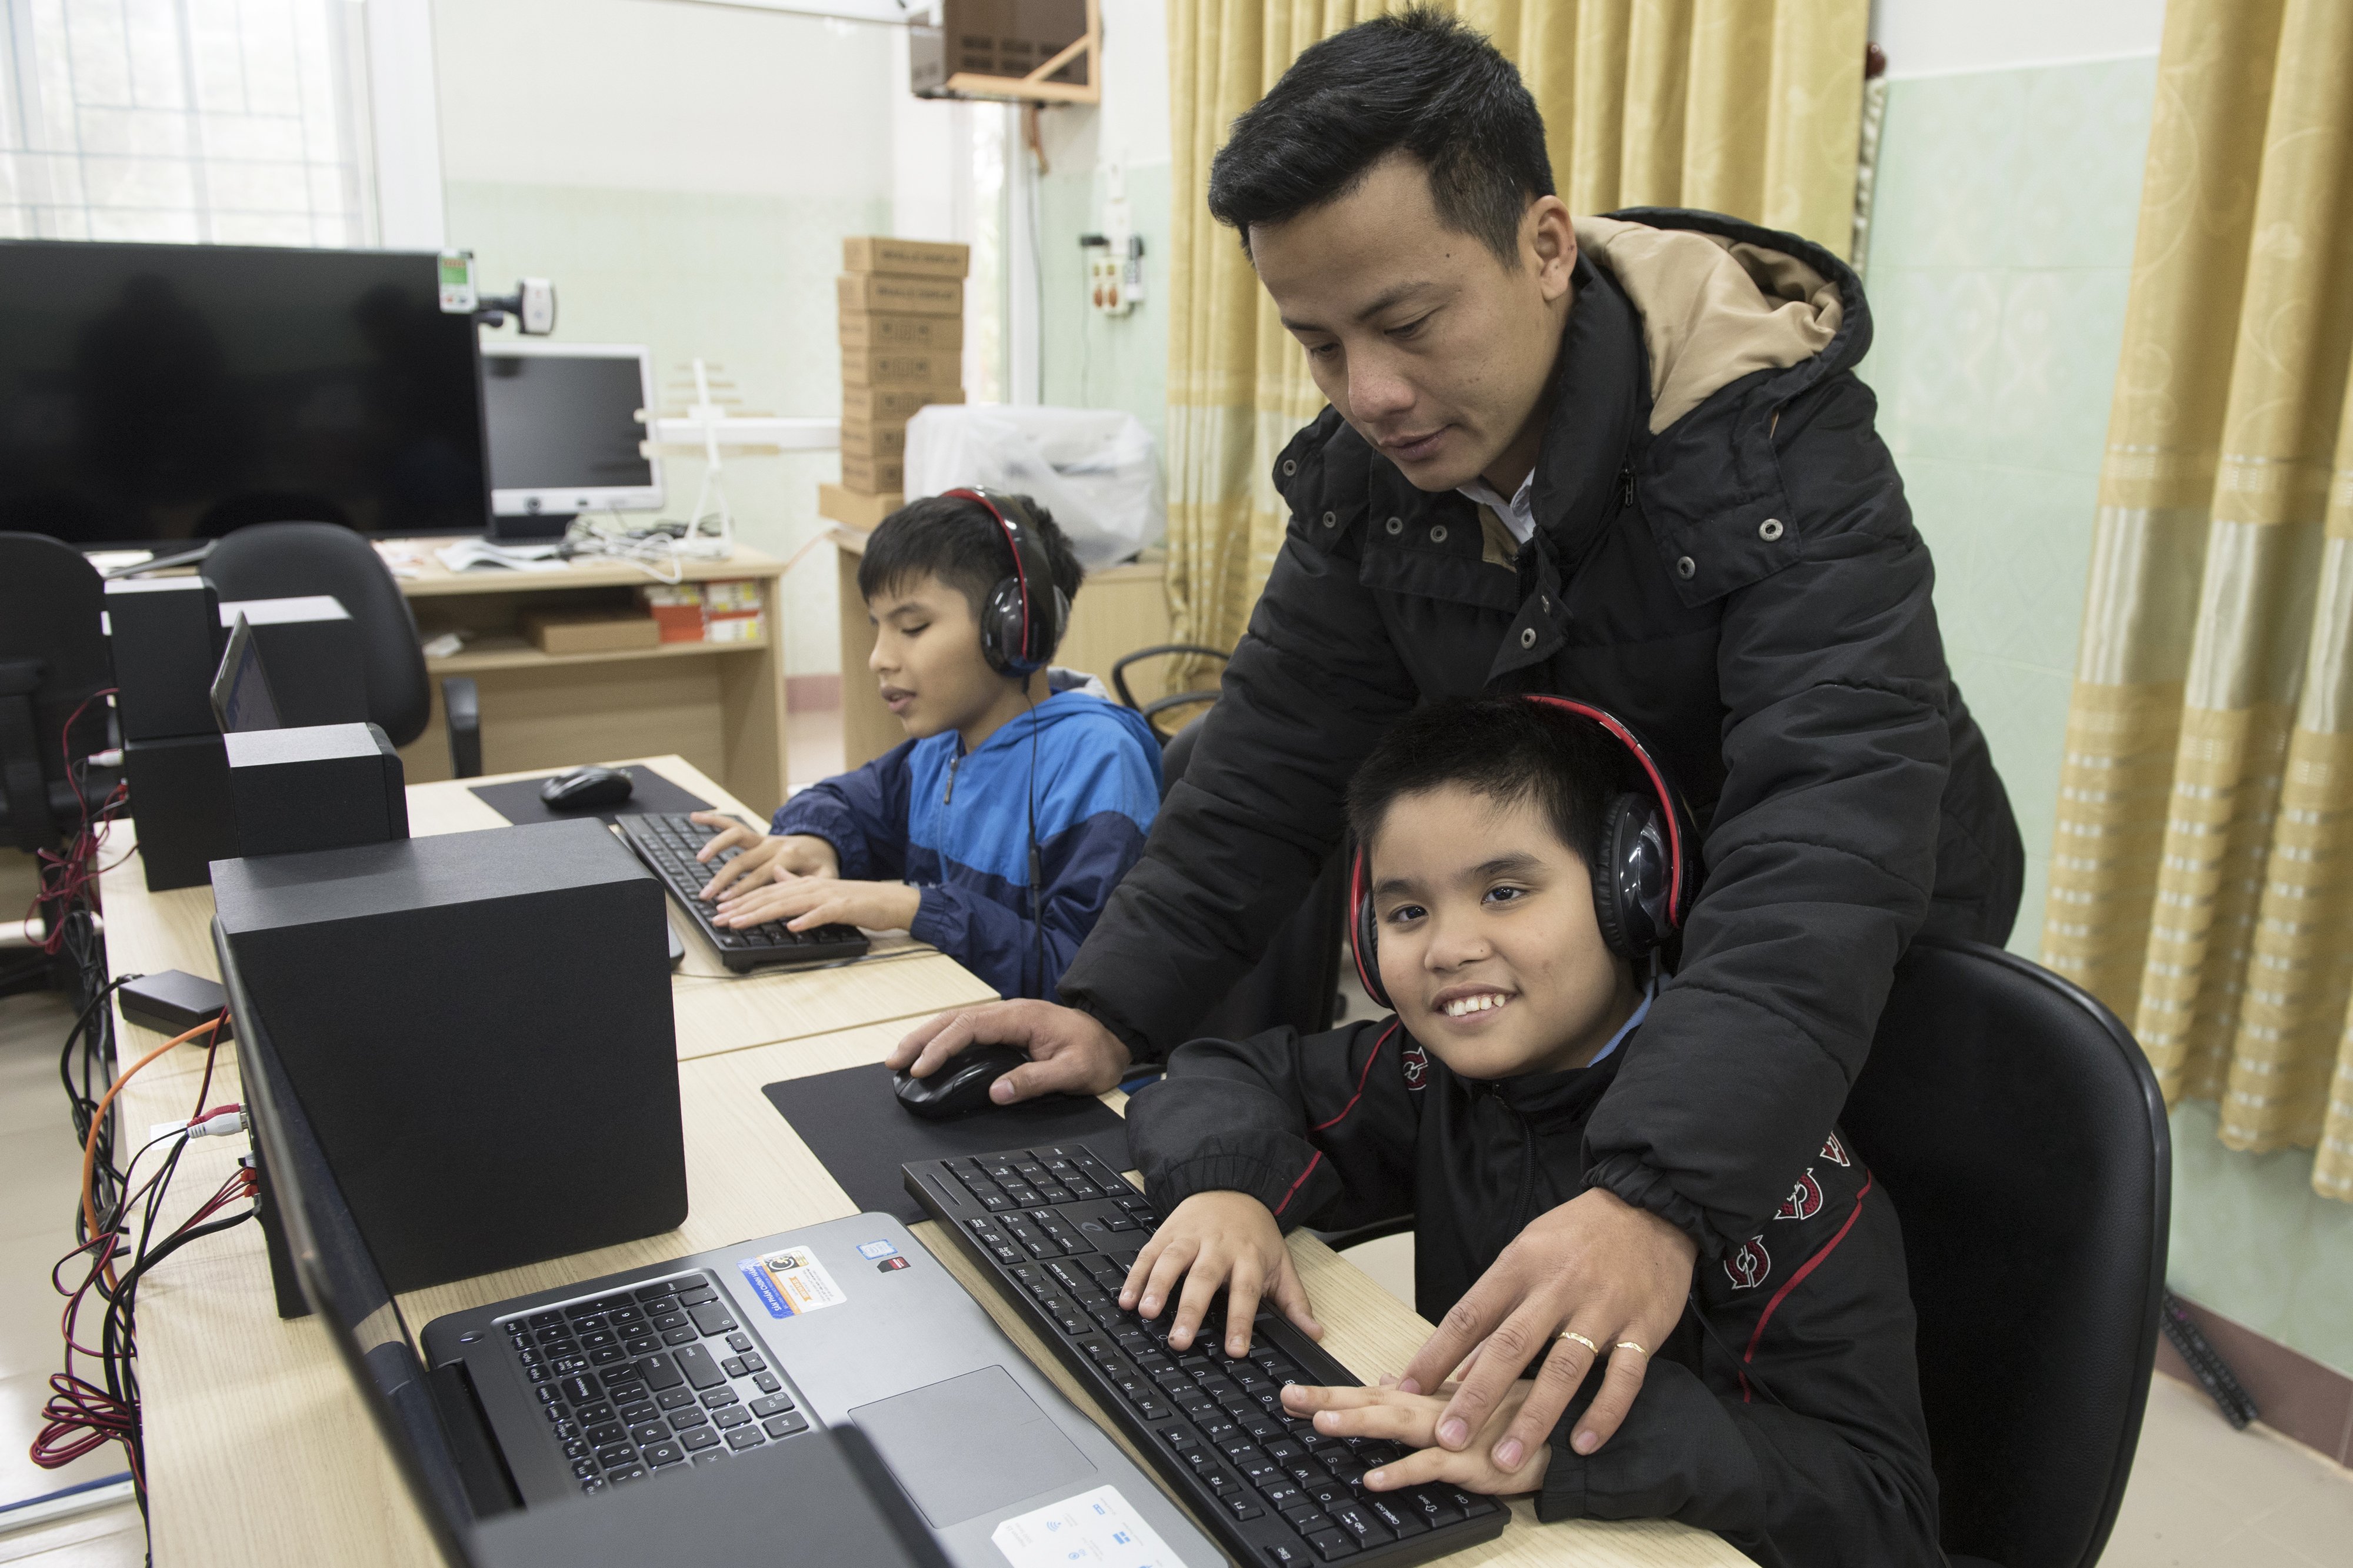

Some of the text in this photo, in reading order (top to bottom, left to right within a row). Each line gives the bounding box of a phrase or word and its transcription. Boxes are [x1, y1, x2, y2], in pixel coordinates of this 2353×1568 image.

[1051, 1263, 1062, 1274] Space
[1048, 1300, 1059, 1309] F10
[575, 1377, 589, 1397] Backspace
[1191, 1455, 1202, 1463] F3
[1295, 1470, 1309, 1478] W
[1211, 1476, 1223, 1485] F2
[1418, 1494, 1430, 1505] Shift
[1455, 1494, 1468, 1504] Ctrl
[1234, 1502, 1246, 1510] F1
[1354, 1522, 1367, 1534] Tab
[1278, 1547, 1291, 1560] Esc
